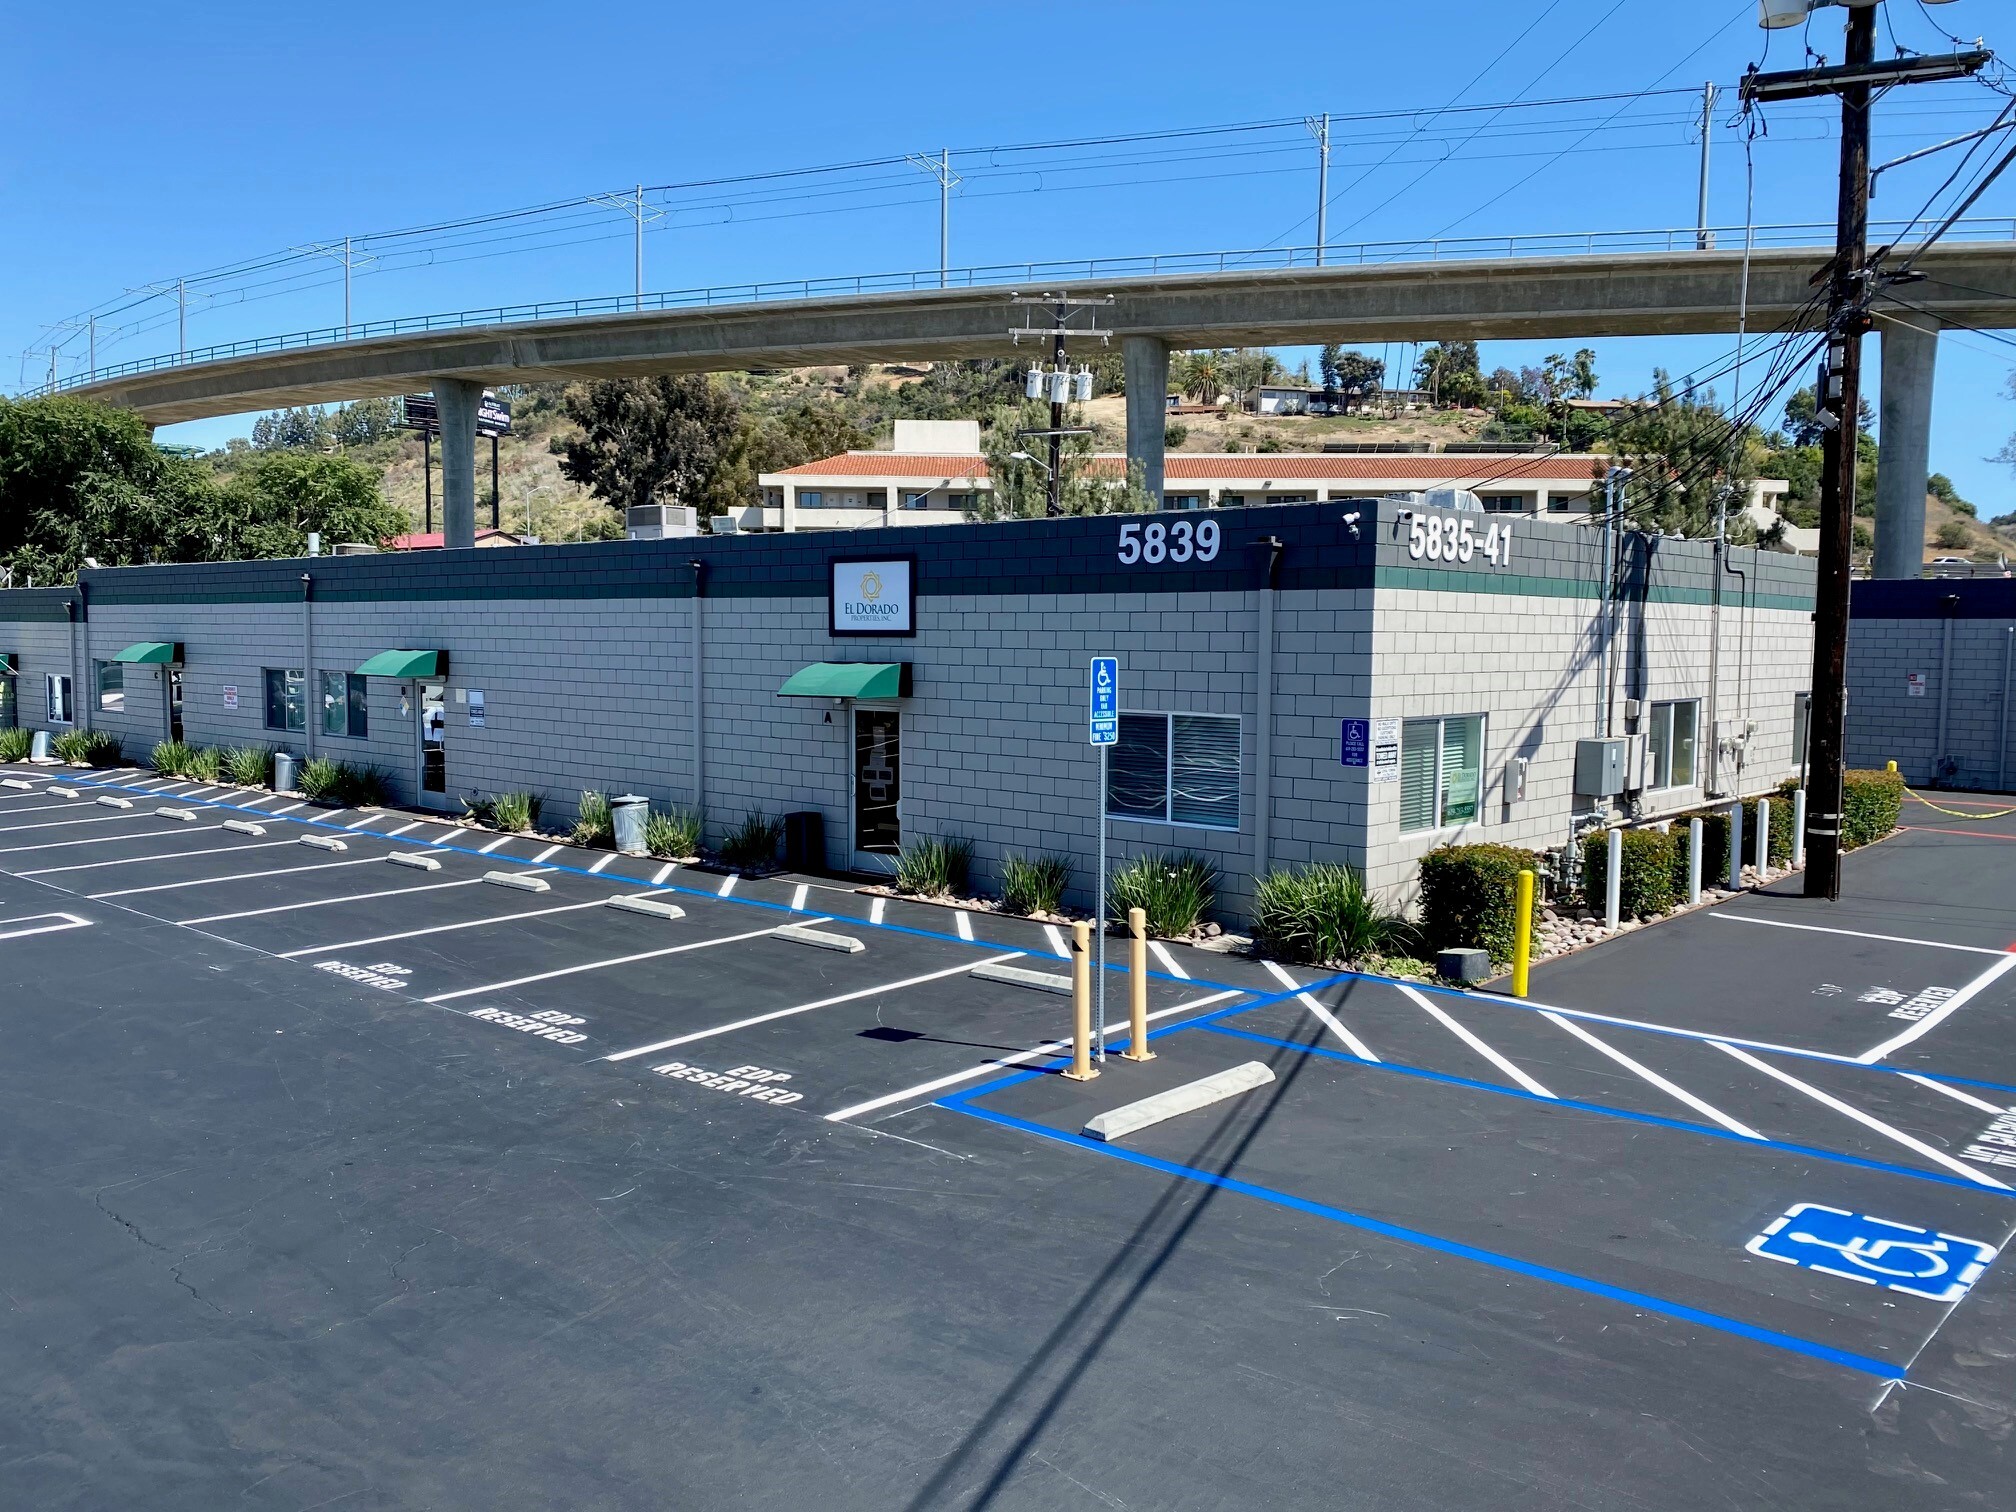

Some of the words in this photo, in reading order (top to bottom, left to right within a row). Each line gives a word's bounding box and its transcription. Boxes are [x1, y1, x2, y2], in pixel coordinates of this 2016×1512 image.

[1118, 520, 1220, 564] 5839
[1409, 513, 1511, 566] 5835-41
[845, 603, 854, 614] EL
[856, 603, 899, 615] DORADO
[824, 711, 832, 723] A
[1094, 710, 1114, 718] ACCESSIBLE
[1095, 722, 1112, 731] MINIMUM
[1092, 733, 1101, 741] FINE
[313, 961, 408, 989] RESERVED
[365, 963, 413, 975] EDP
[1887, 986, 1958, 1021] RESERVED
[467, 1007, 588, 1044] RESERVED
[529, 1010, 586, 1026] EDP
[724, 1065, 792, 1083] EDP
[652, 1062, 804, 1104] RESERVED
